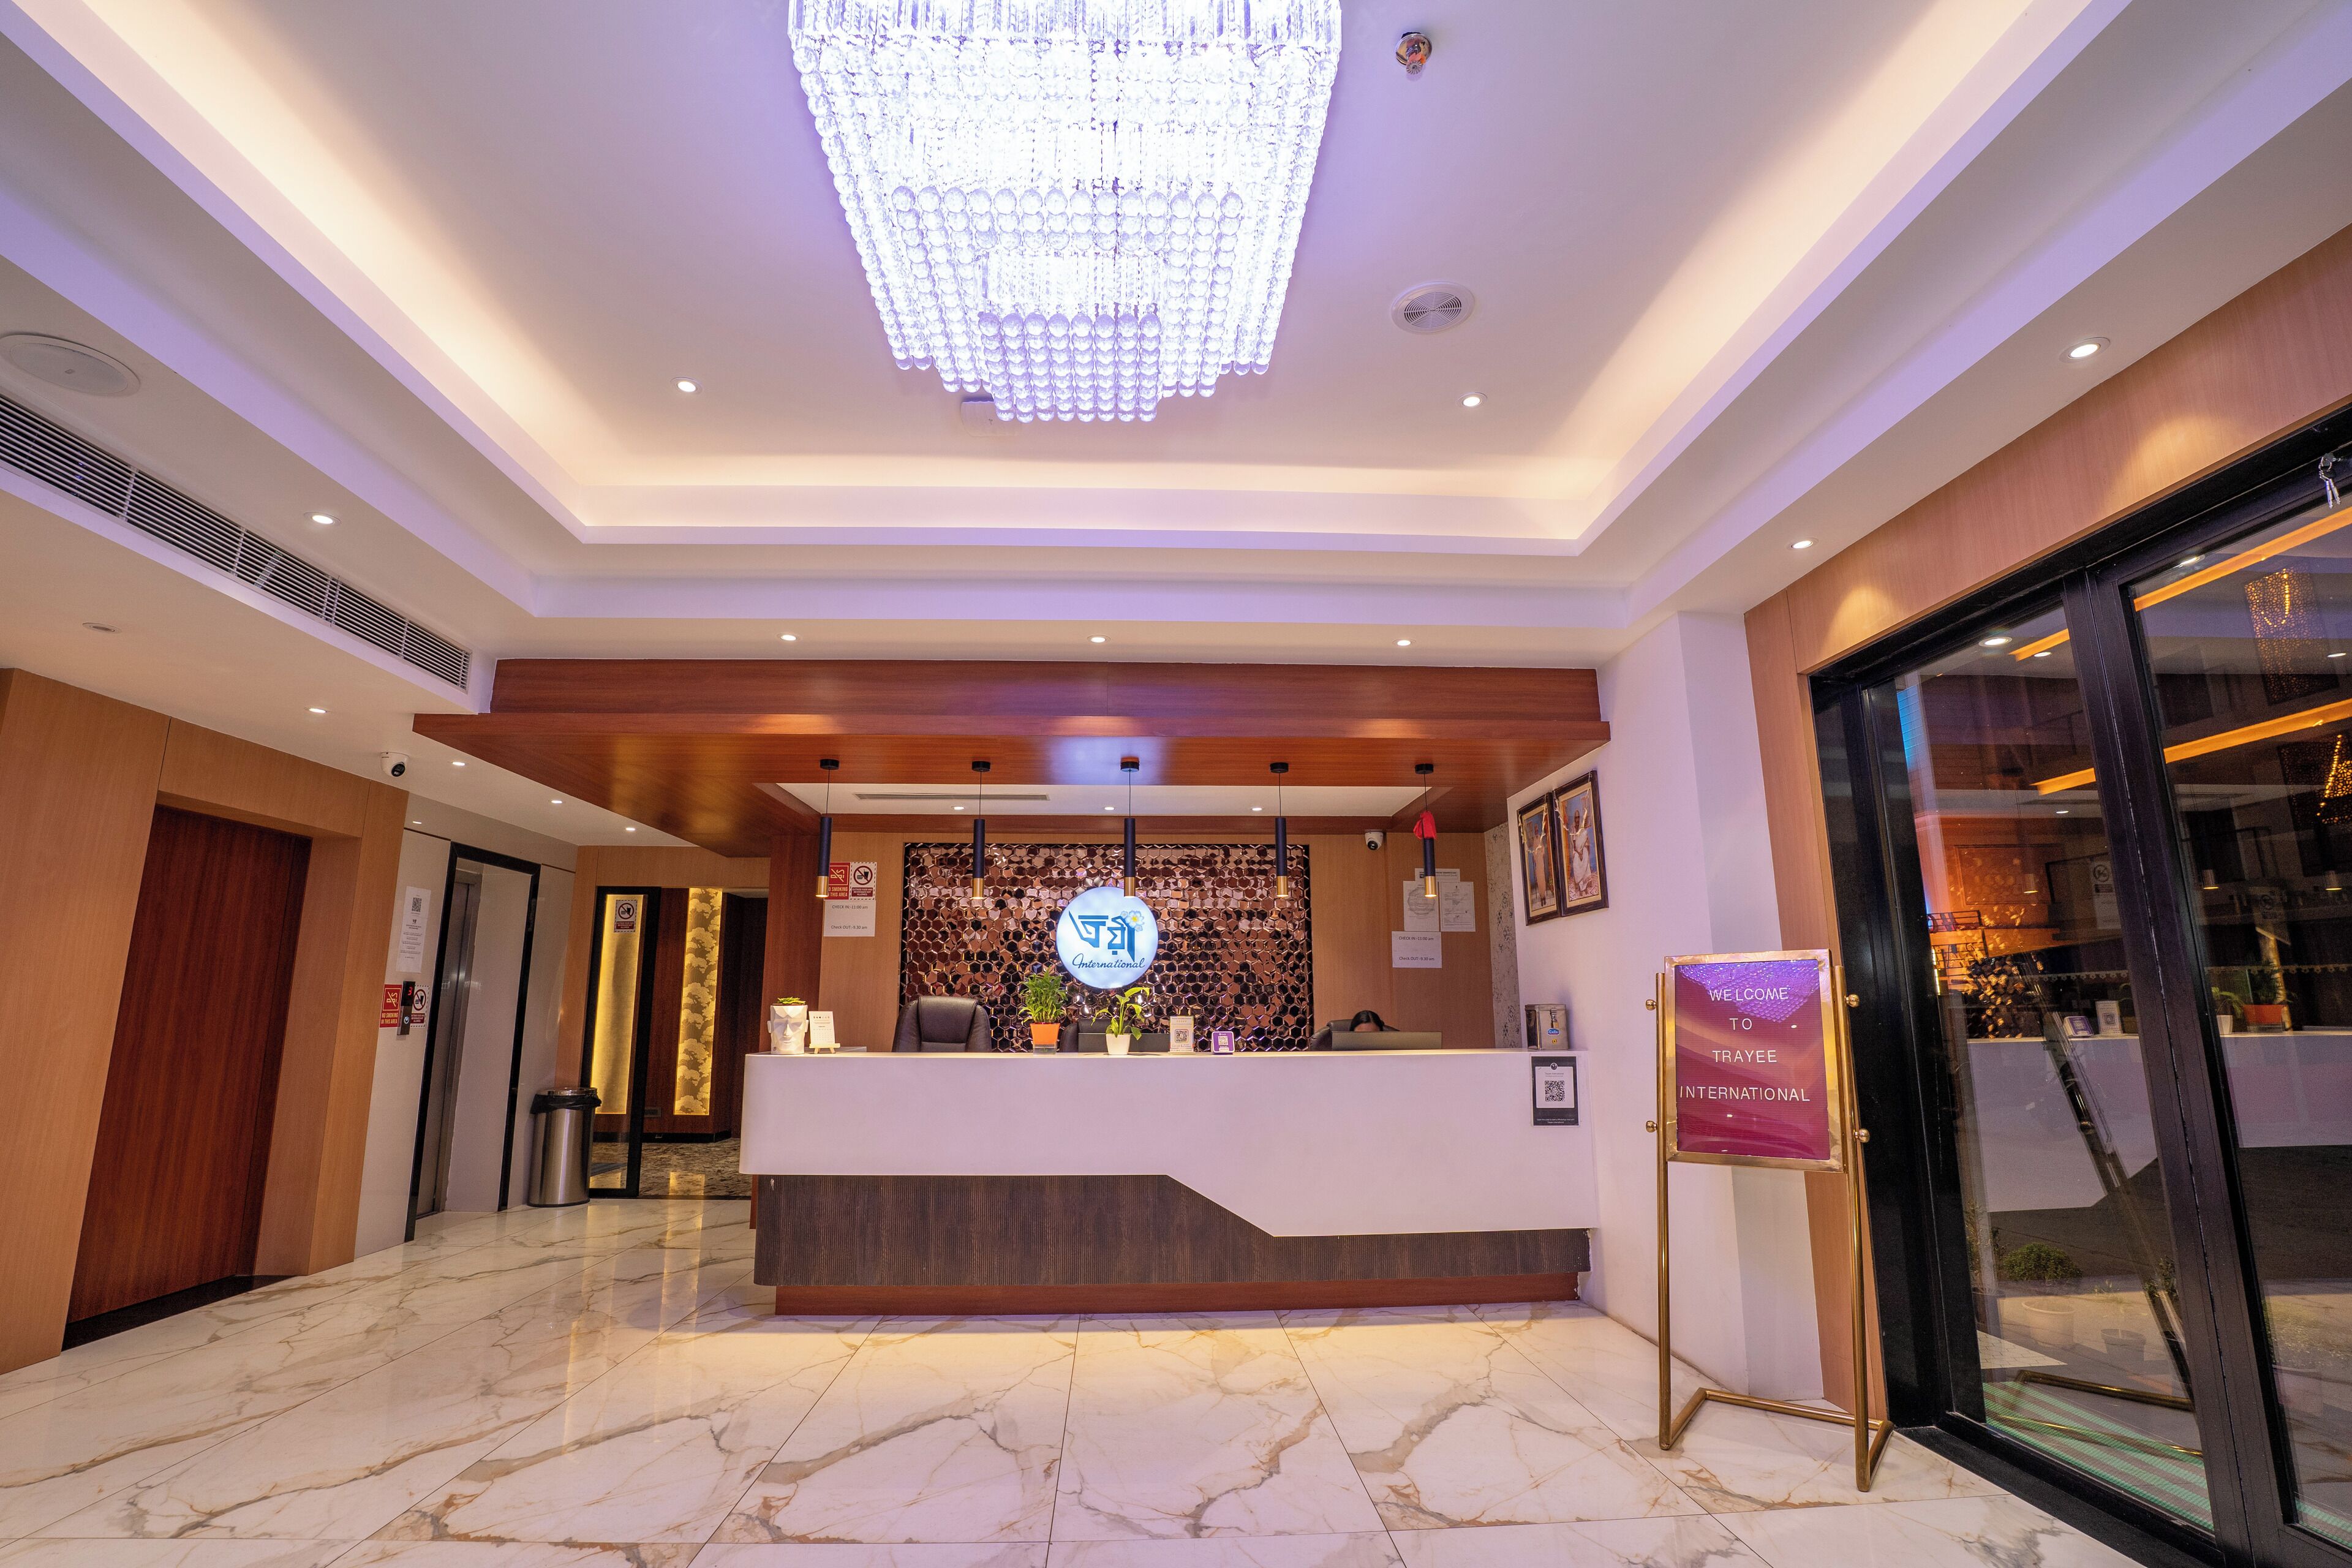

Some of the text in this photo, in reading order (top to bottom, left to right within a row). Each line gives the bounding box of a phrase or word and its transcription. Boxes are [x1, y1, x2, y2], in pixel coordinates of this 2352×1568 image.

[1072, 953, 1145, 969] International
[407, 987, 413, 995] 3
[1709, 987, 1789, 1001] WELCOME
[1730, 1018, 1752, 1030] TO
[1713, 1050, 1777, 1063] TRAYEE
[1680, 1086, 1810, 1101] INTERNATIONAL
